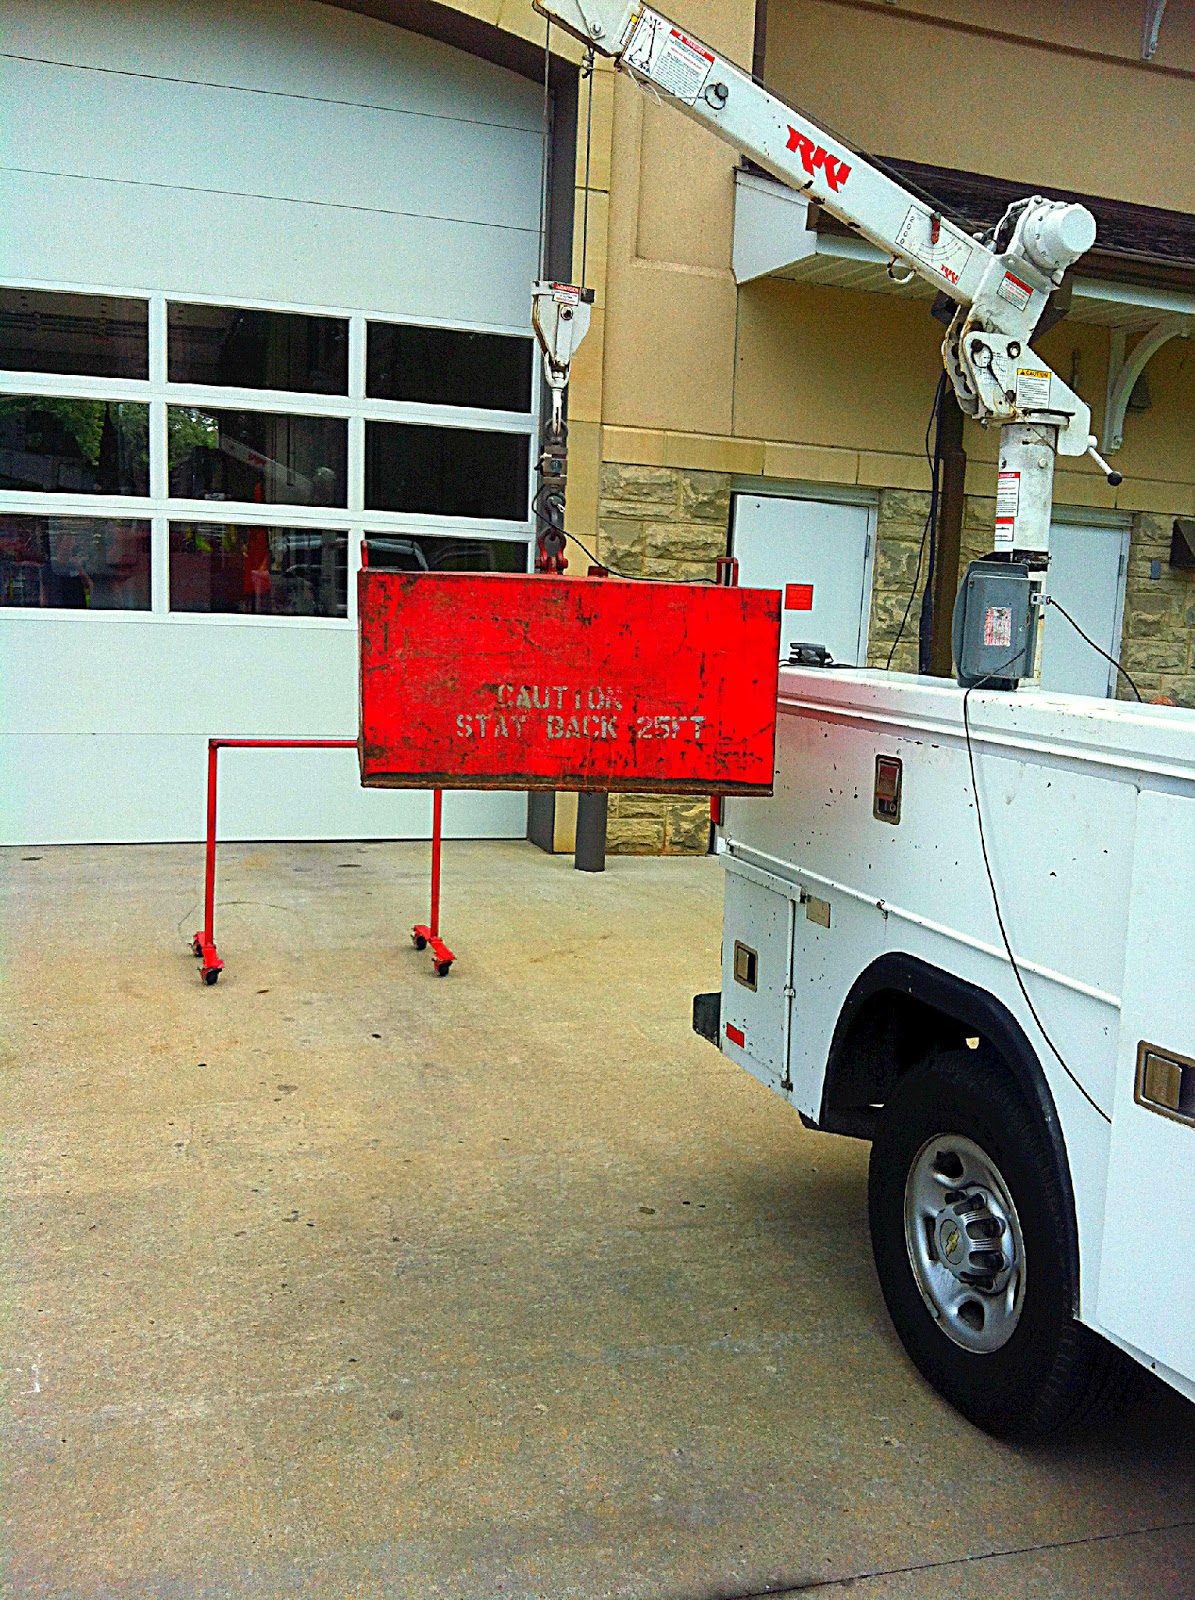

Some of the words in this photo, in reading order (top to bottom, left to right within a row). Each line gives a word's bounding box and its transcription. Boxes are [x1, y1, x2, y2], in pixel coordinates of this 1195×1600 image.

[786, 124, 852, 193] RKI
[899, 215, 916, 245] 2000
[1025, 370, 1049, 379] CAUTION
[498, 684, 622, 710] CAUTION
[456, 715, 526, 738] STAY
[547, 715, 617, 739] BACK
[637, 715, 705, 739] 25FT
